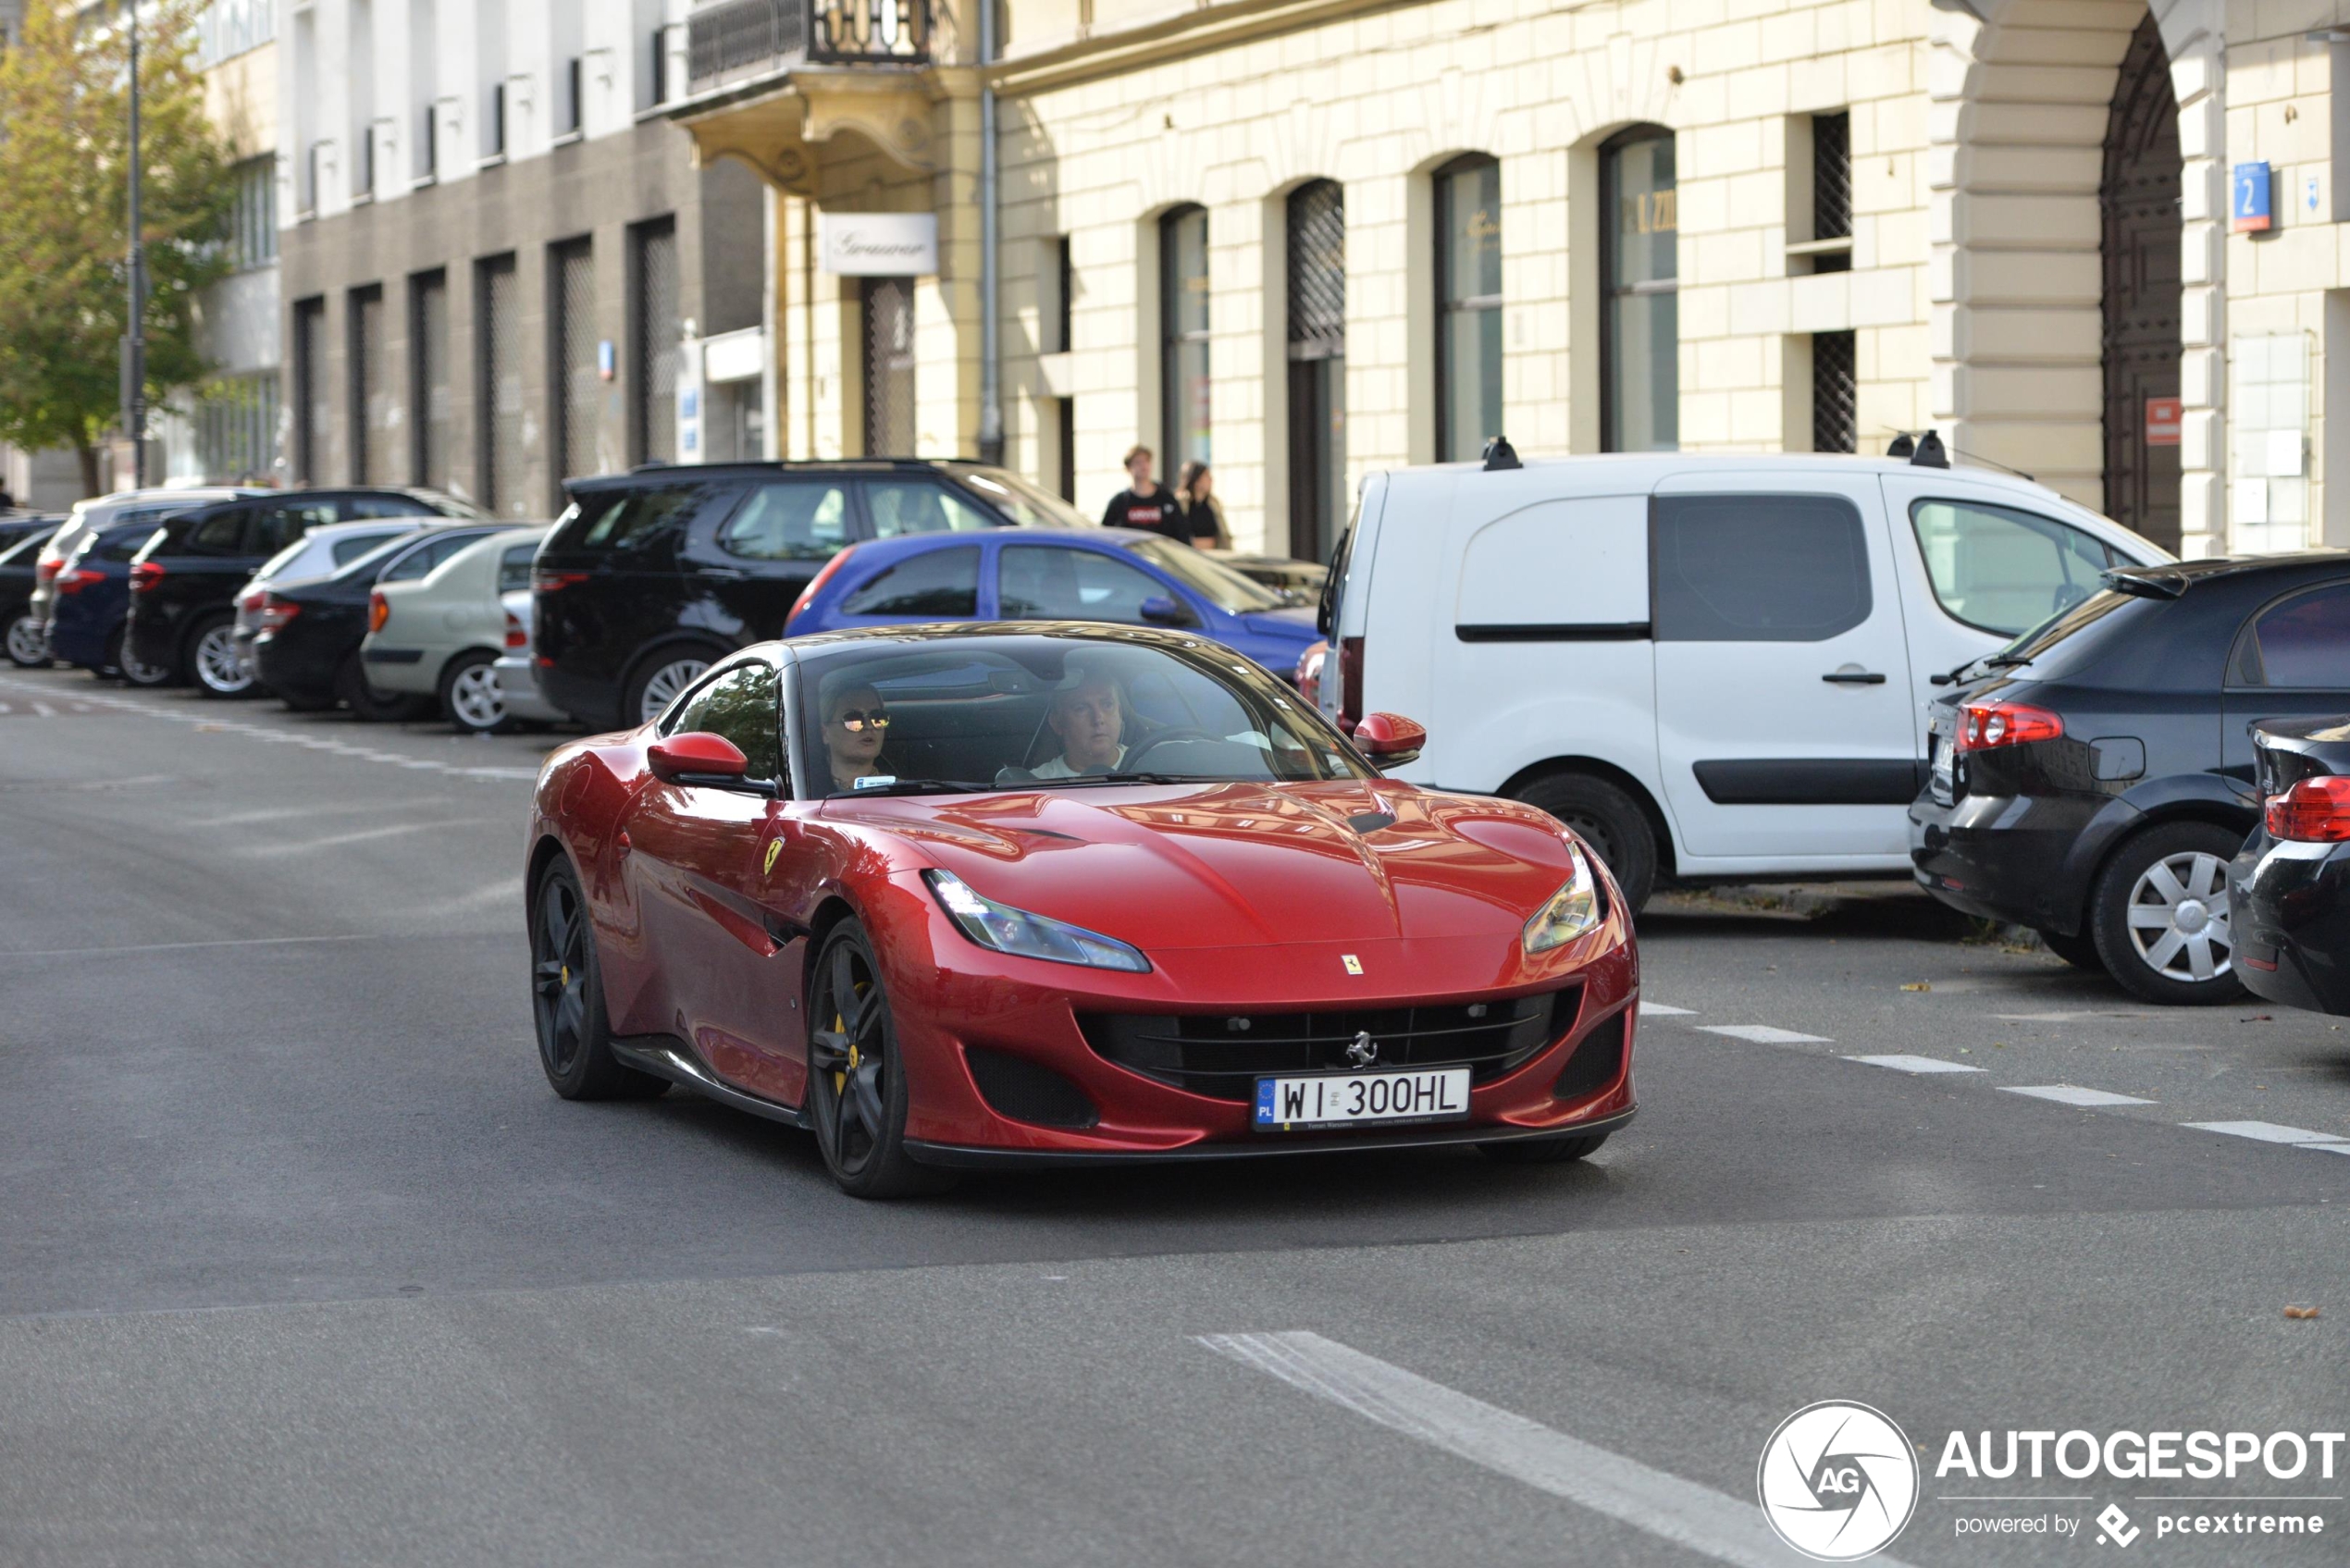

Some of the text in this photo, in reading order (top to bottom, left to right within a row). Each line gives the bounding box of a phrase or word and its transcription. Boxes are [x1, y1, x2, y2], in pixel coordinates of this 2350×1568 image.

[2242, 178, 2255, 215] 2
[1259, 1106, 1272, 1117] PL
[1284, 1075, 1457, 1119] WI 300HL
